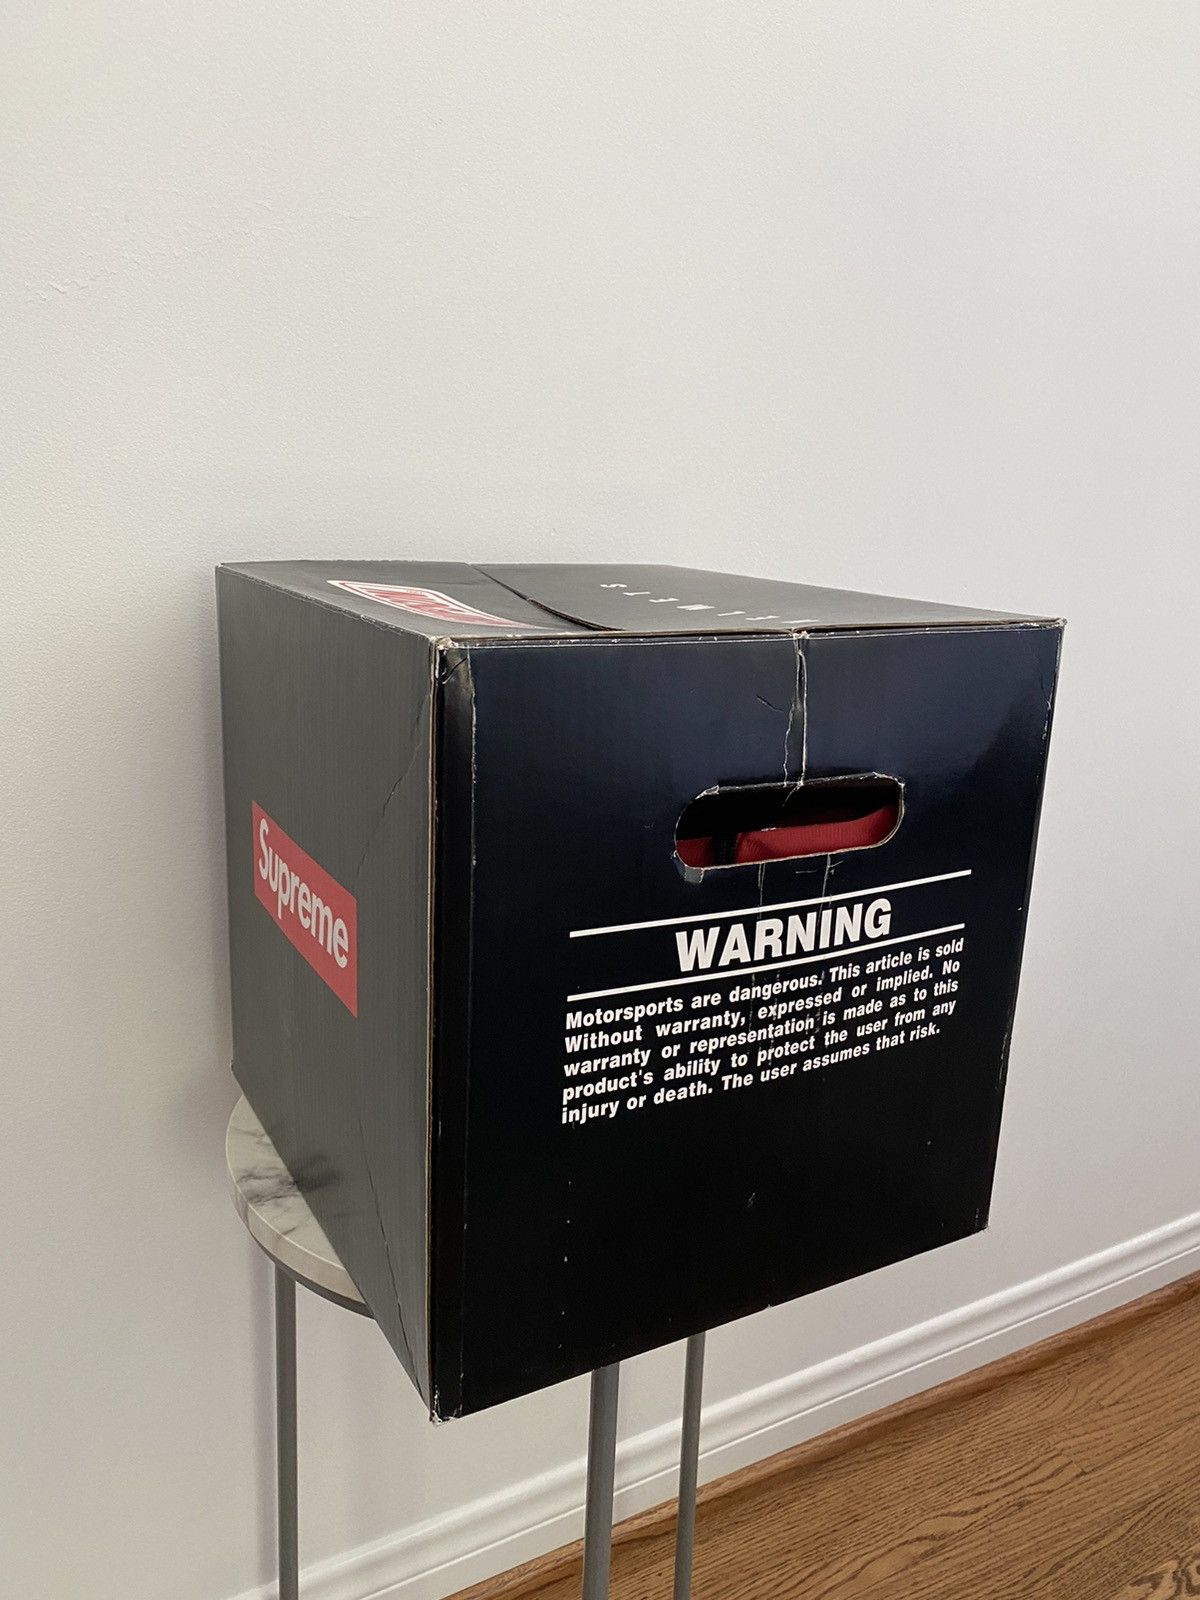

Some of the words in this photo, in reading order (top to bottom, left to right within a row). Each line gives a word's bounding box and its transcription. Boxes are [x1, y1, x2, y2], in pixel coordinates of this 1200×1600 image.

[258, 818, 349, 969] Supreme
[675, 897, 892, 972] WARNING
[563, 1050, 651, 1077] warranty
[661, 1042, 681, 1059] or
[689, 1016, 814, 1055] representation
[822, 1010, 837, 1026] is
[843, 999, 883, 1022] made
[889, 993, 907, 1008] as
[913, 986, 928, 1002] to
[933, 979, 959, 996] this
[564, 1025, 643, 1054] Without
[656, 1009, 747, 1038] warranty,
[757, 987, 842, 1019] expressed
[851, 981, 868, 998] or
[875, 966, 933, 995] implied.
[942, 959, 961, 976] No
[566, 995, 684, 1030] Motorsports
[691, 991, 722, 1008] are
[729, 974, 823, 1002] dangerous.
[829, 966, 861, 983] This
[865, 952, 913, 974] article
[917, 946, 931, 962] is
[935, 938, 964, 958] sold
[561, 1094, 620, 1125] injury
[626, 1092, 647, 1111] or
[653, 1079, 714, 1106] death.
[721, 1074, 754, 1091] The
[760, 1063, 797, 1083] user
[802, 1045, 870, 1072] assumes
[875, 1034, 905, 1052] that
[909, 1024, 941, 1043] risk.
[562, 1070, 654, 1105] product's
[663, 1057, 721, 1083] ability
[730, 1051, 748, 1068] to
[756, 1036, 816, 1067] protect
[824, 1030, 849, 1048] the
[856, 1022, 889, 1038] user
[894, 1009, 926, 1028] from
[932, 999, 956, 1019] any
